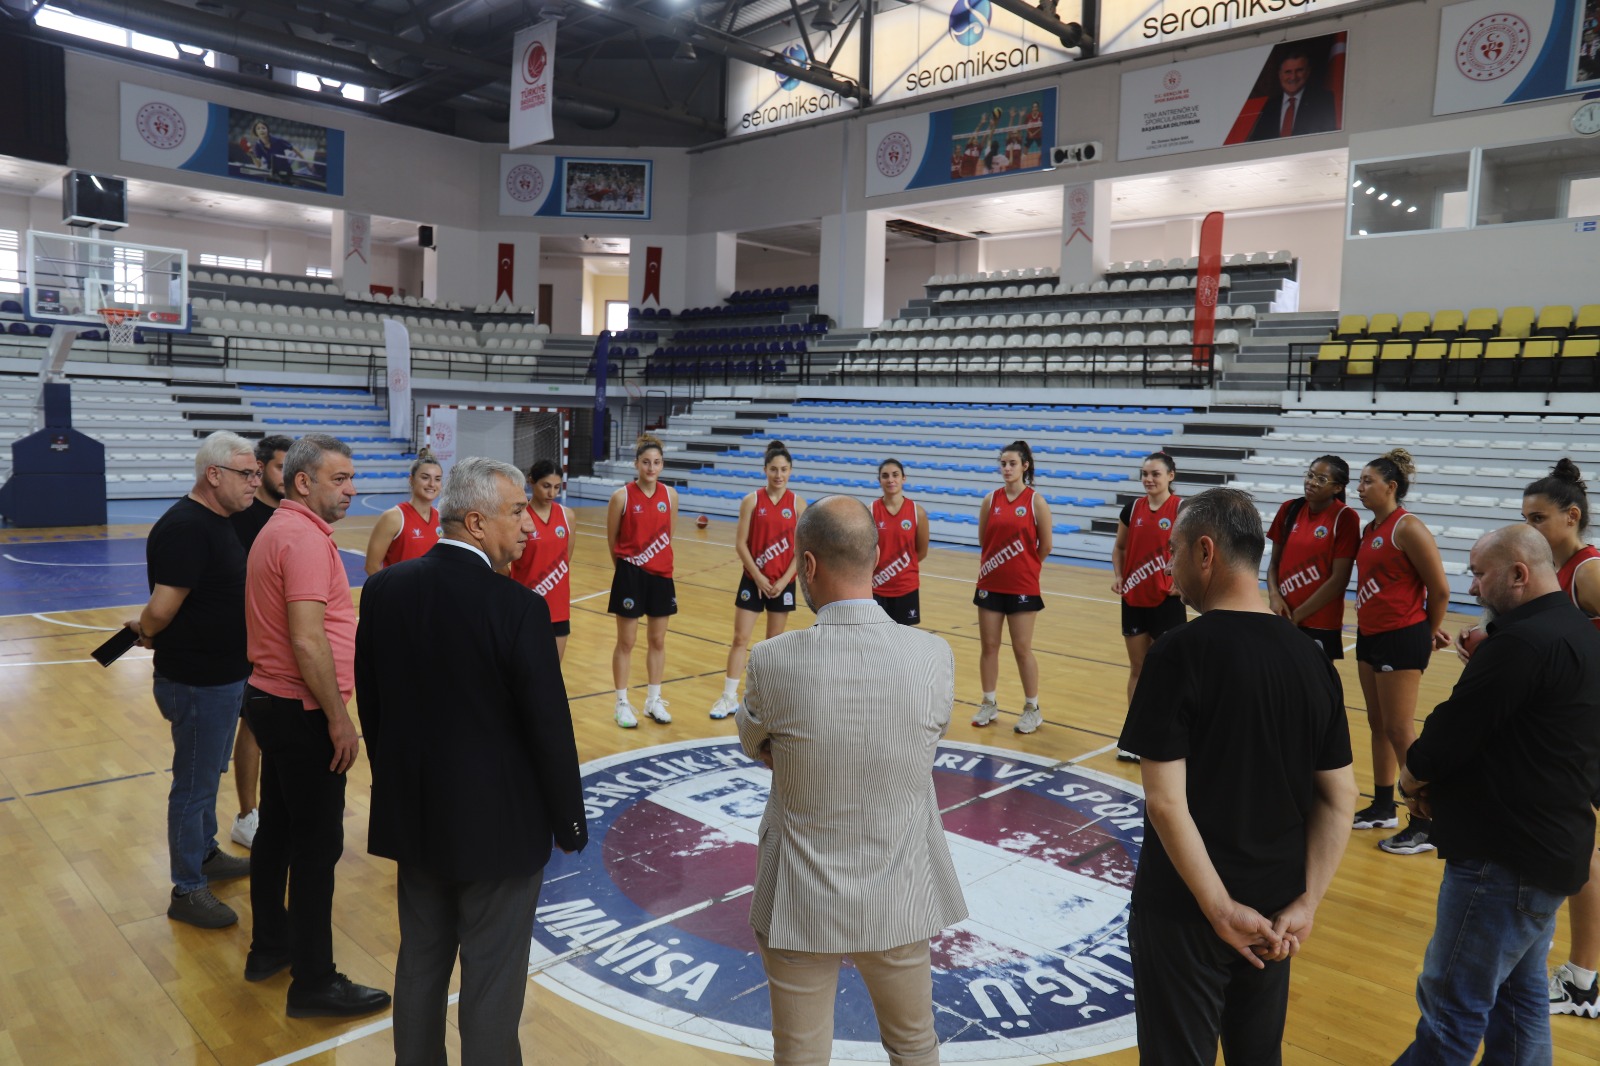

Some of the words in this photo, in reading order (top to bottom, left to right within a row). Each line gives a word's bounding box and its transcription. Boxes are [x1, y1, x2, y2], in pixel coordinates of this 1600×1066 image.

[906, 43, 1039, 92] seramiksan
[742, 92, 842, 129] seramiksan
[1144, 111, 1157, 119] TÜM
[1280, 564, 1321, 597] GUTLU
[994, 763, 1055, 788] VE
[535, 898, 720, 1002] MANİSA
